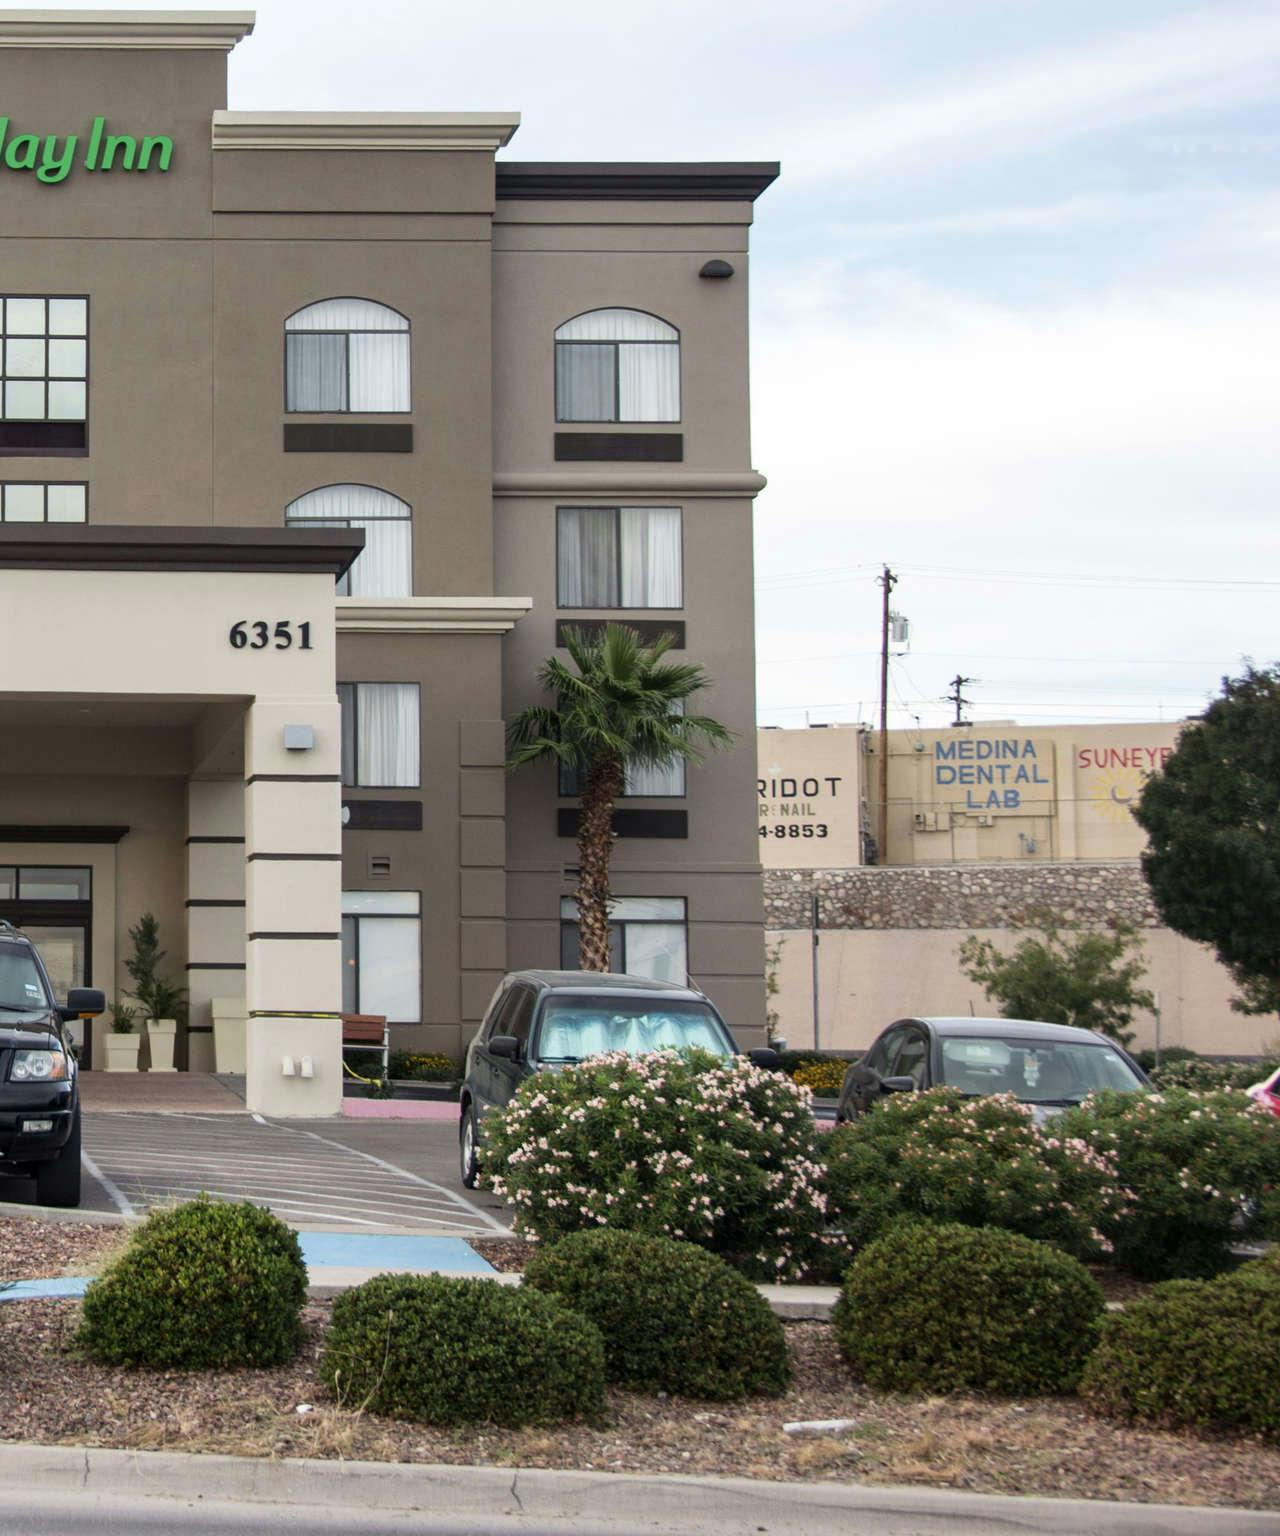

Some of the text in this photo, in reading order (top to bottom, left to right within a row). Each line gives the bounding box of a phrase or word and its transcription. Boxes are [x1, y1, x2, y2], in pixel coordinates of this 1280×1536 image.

[86, 116, 174, 172] Inn
[229, 620, 313, 649] 6351
[935, 740, 1037, 760] MEDINA
[936, 764, 1049, 785] DENTAL
[966, 789, 1021, 808] LAB
[780, 803, 816, 816] NAIL
[759, 824, 828, 838] 4-8853
